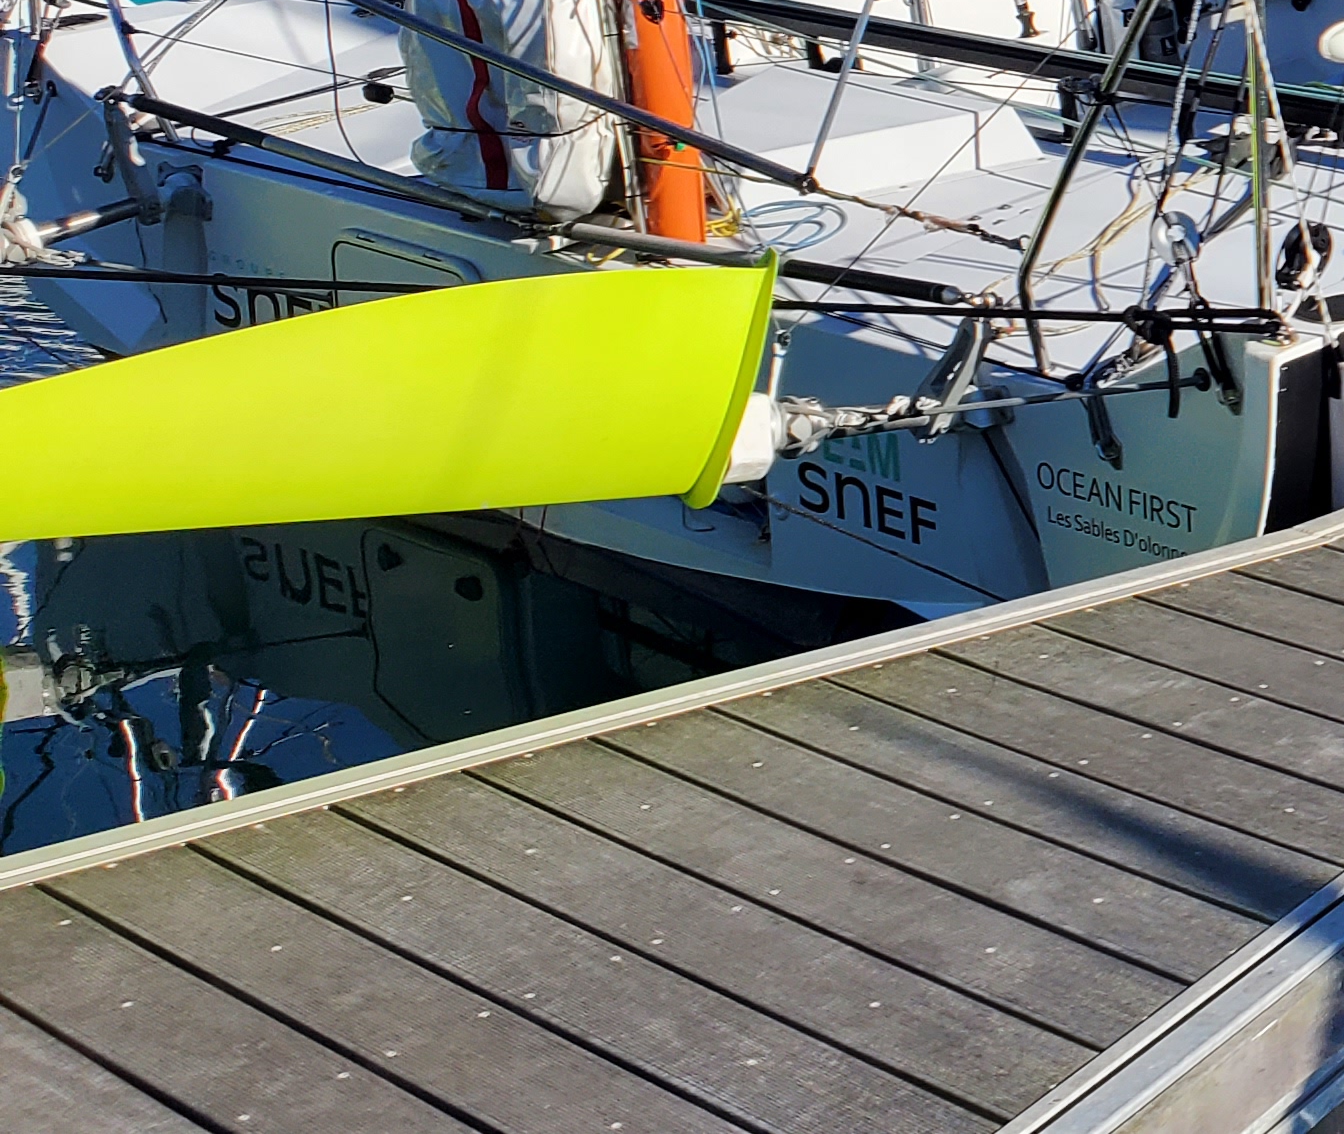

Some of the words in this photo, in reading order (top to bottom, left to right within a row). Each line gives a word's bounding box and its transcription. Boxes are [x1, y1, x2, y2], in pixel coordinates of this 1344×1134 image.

[1036, 461, 1122, 512] OCEAN
[1128, 488, 1198, 534] FIRST
[1047, 506, 1071, 528] Les
[1075, 515, 1120, 544] Sables
